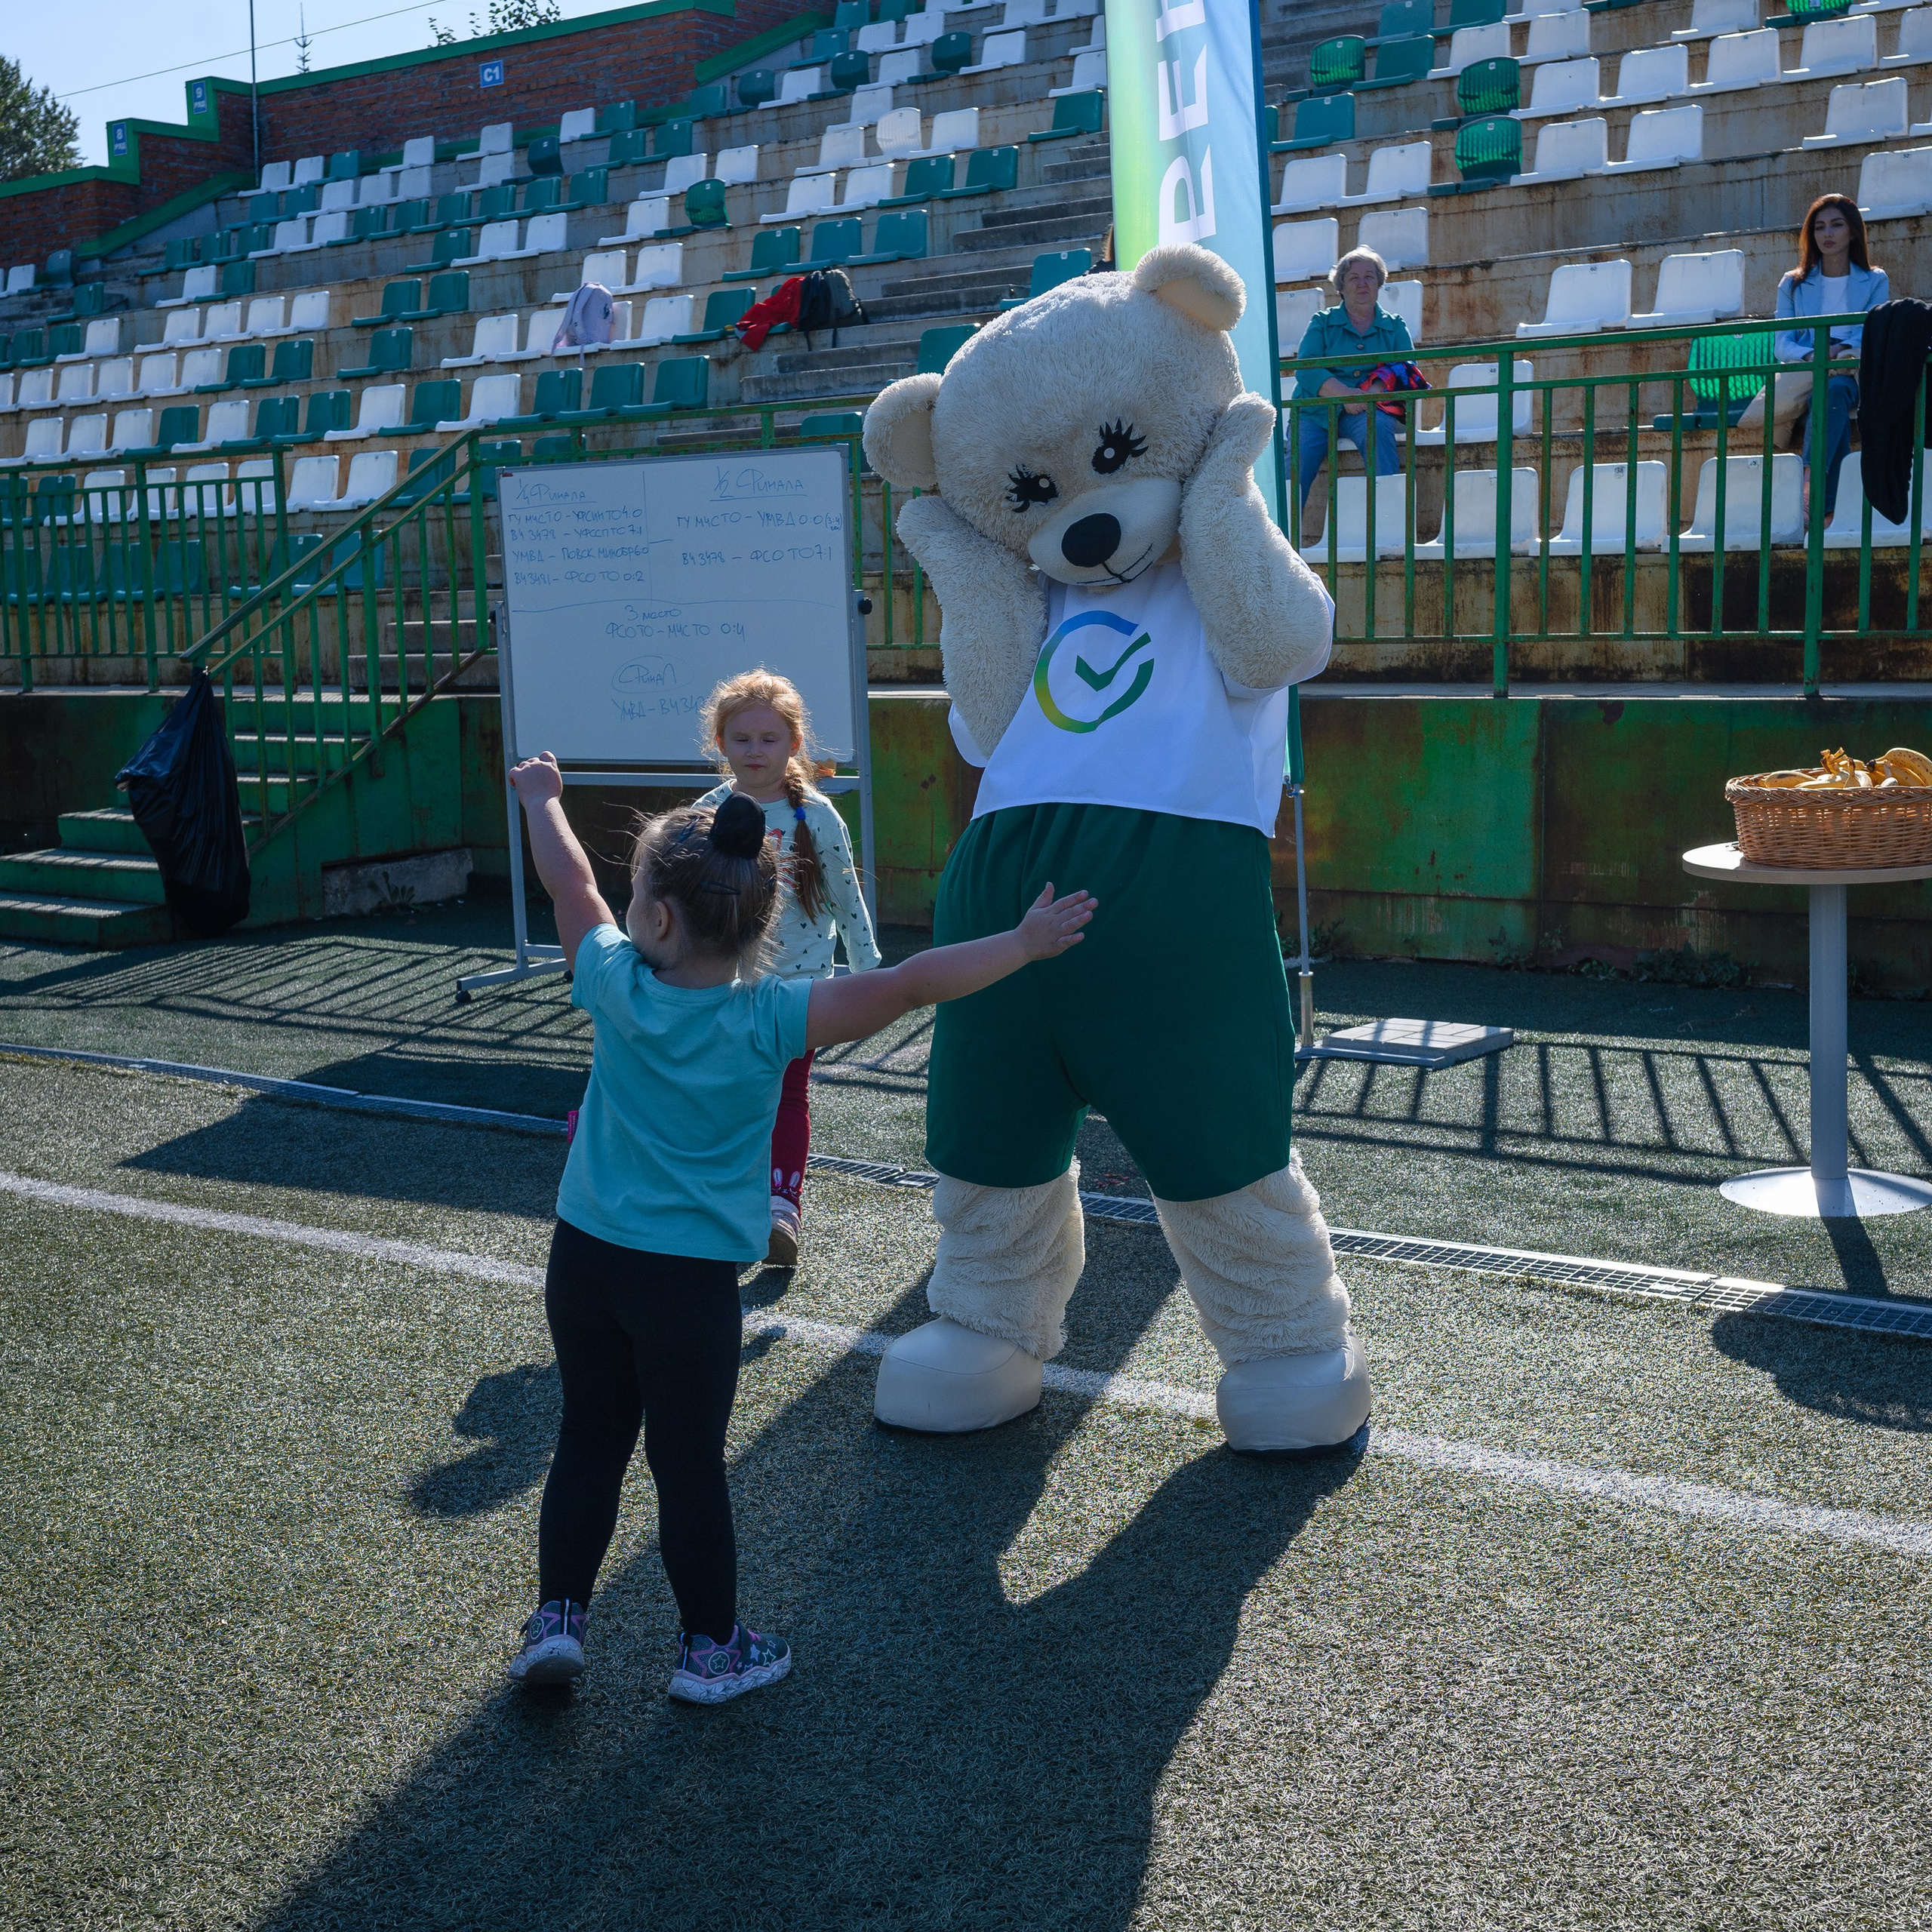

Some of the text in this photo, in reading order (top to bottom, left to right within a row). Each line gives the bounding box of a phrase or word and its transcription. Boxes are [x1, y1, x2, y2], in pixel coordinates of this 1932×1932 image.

[484, 66, 500, 82] C1
[196, 87, 202, 99] 9
[116, 128, 123, 140] 8
[736, 468, 804, 494] Финала
[530, 483, 586, 502] Финала
[508, 514, 521, 525] ГУ
[677, 515, 690, 528] ГУ
[512, 549, 545, 564] УМВД
[624, 605, 639, 621] 3
[618, 663, 678, 687] Финал
